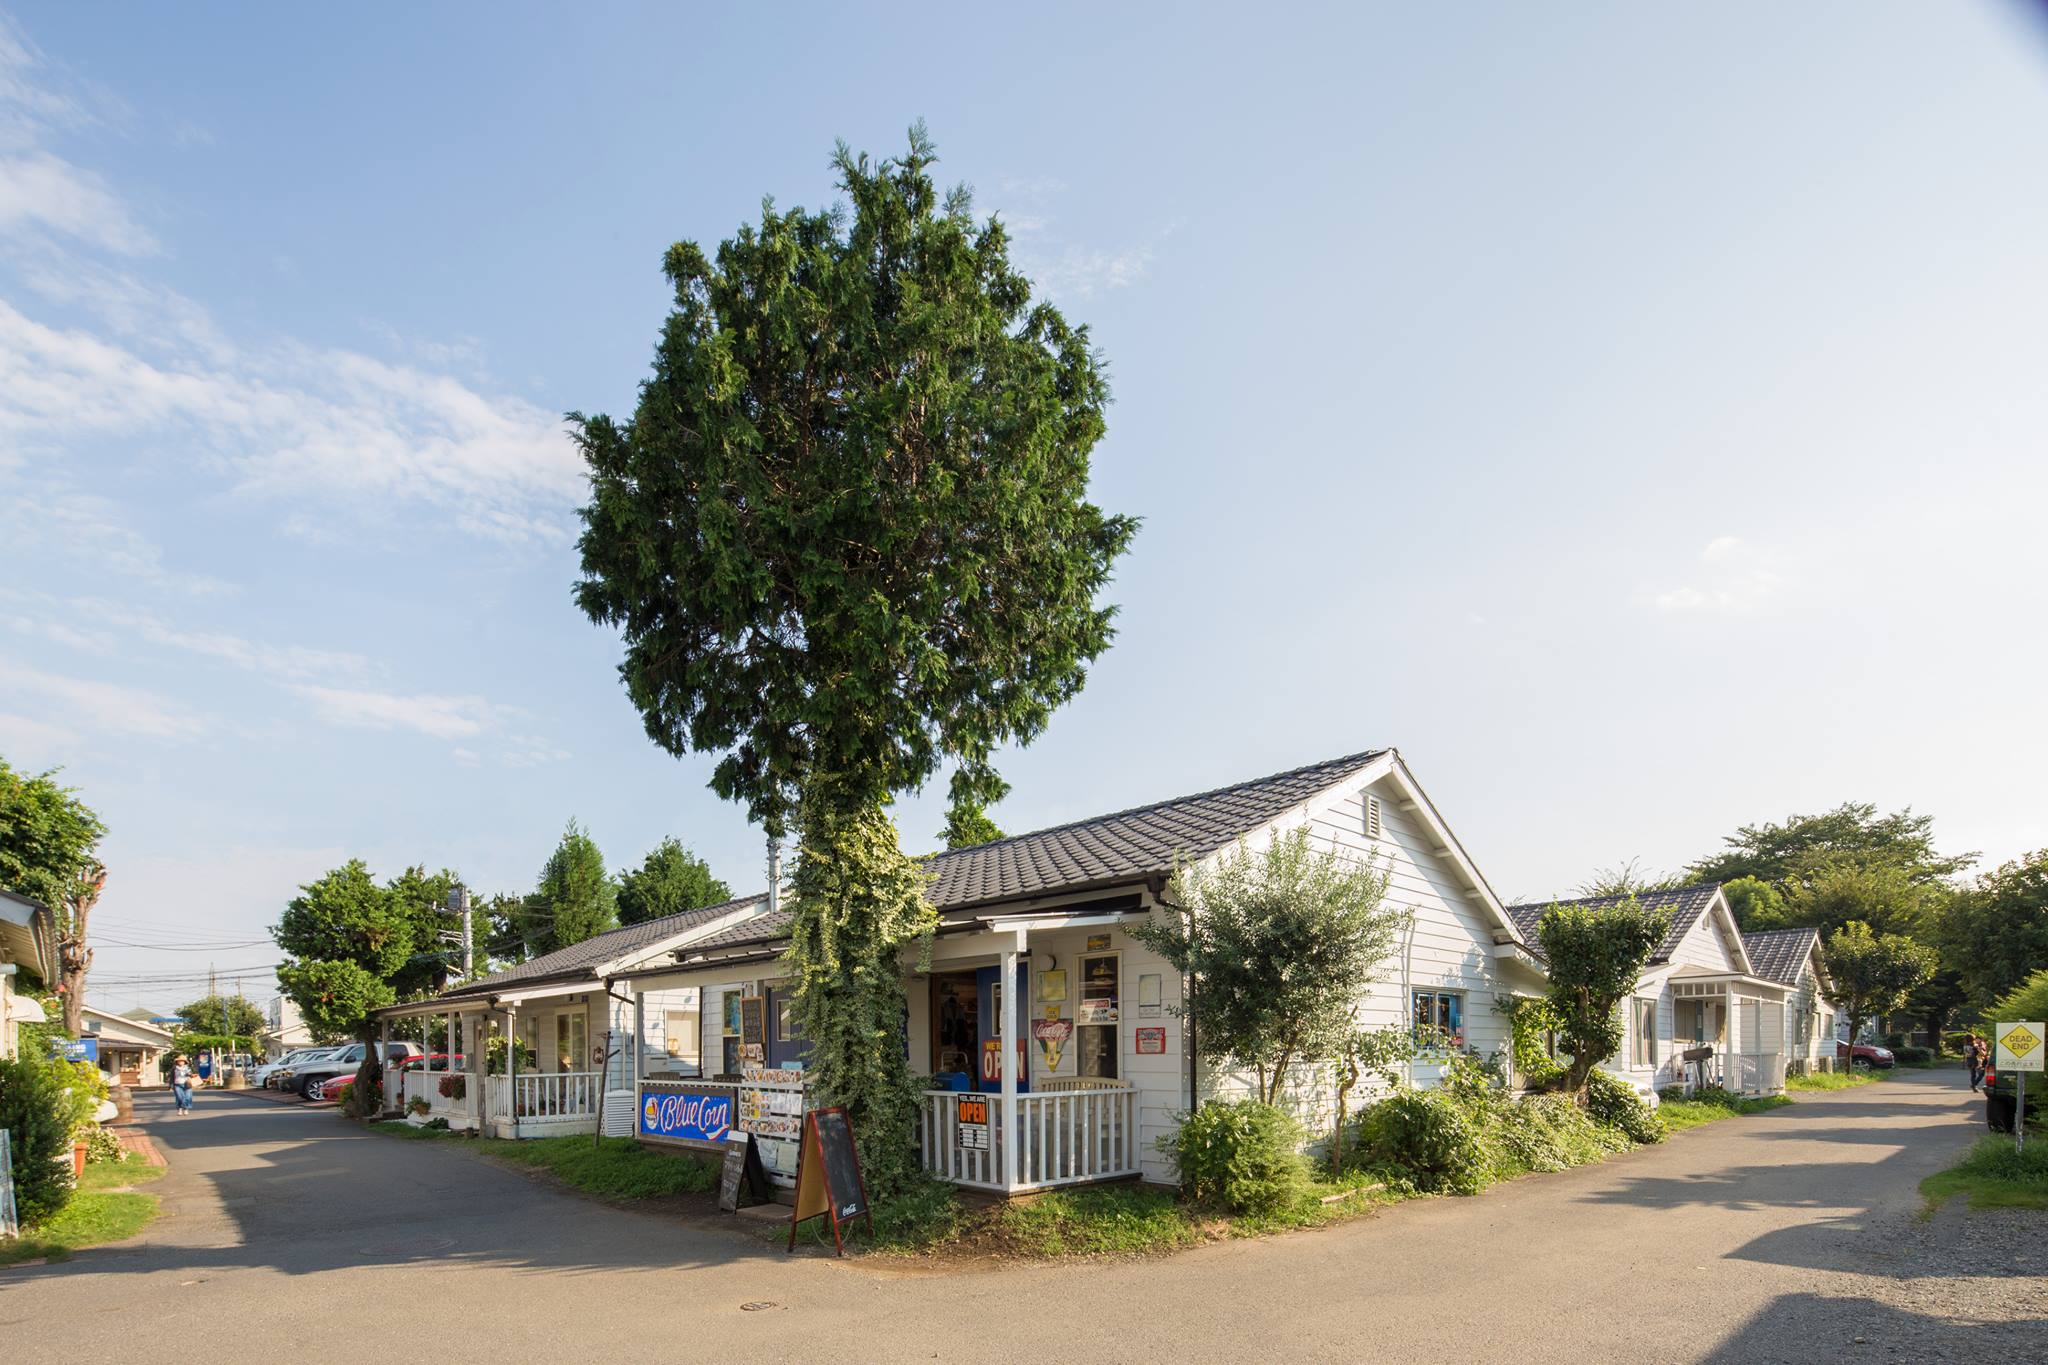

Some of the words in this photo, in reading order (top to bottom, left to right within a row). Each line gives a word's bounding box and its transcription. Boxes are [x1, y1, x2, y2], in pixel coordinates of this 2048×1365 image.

[985, 1051, 1024, 1079] OPN
[660, 1095, 698, 1133] Blue
[698, 1096, 729, 1134] Corn
[960, 1102, 986, 1123] OPEN
